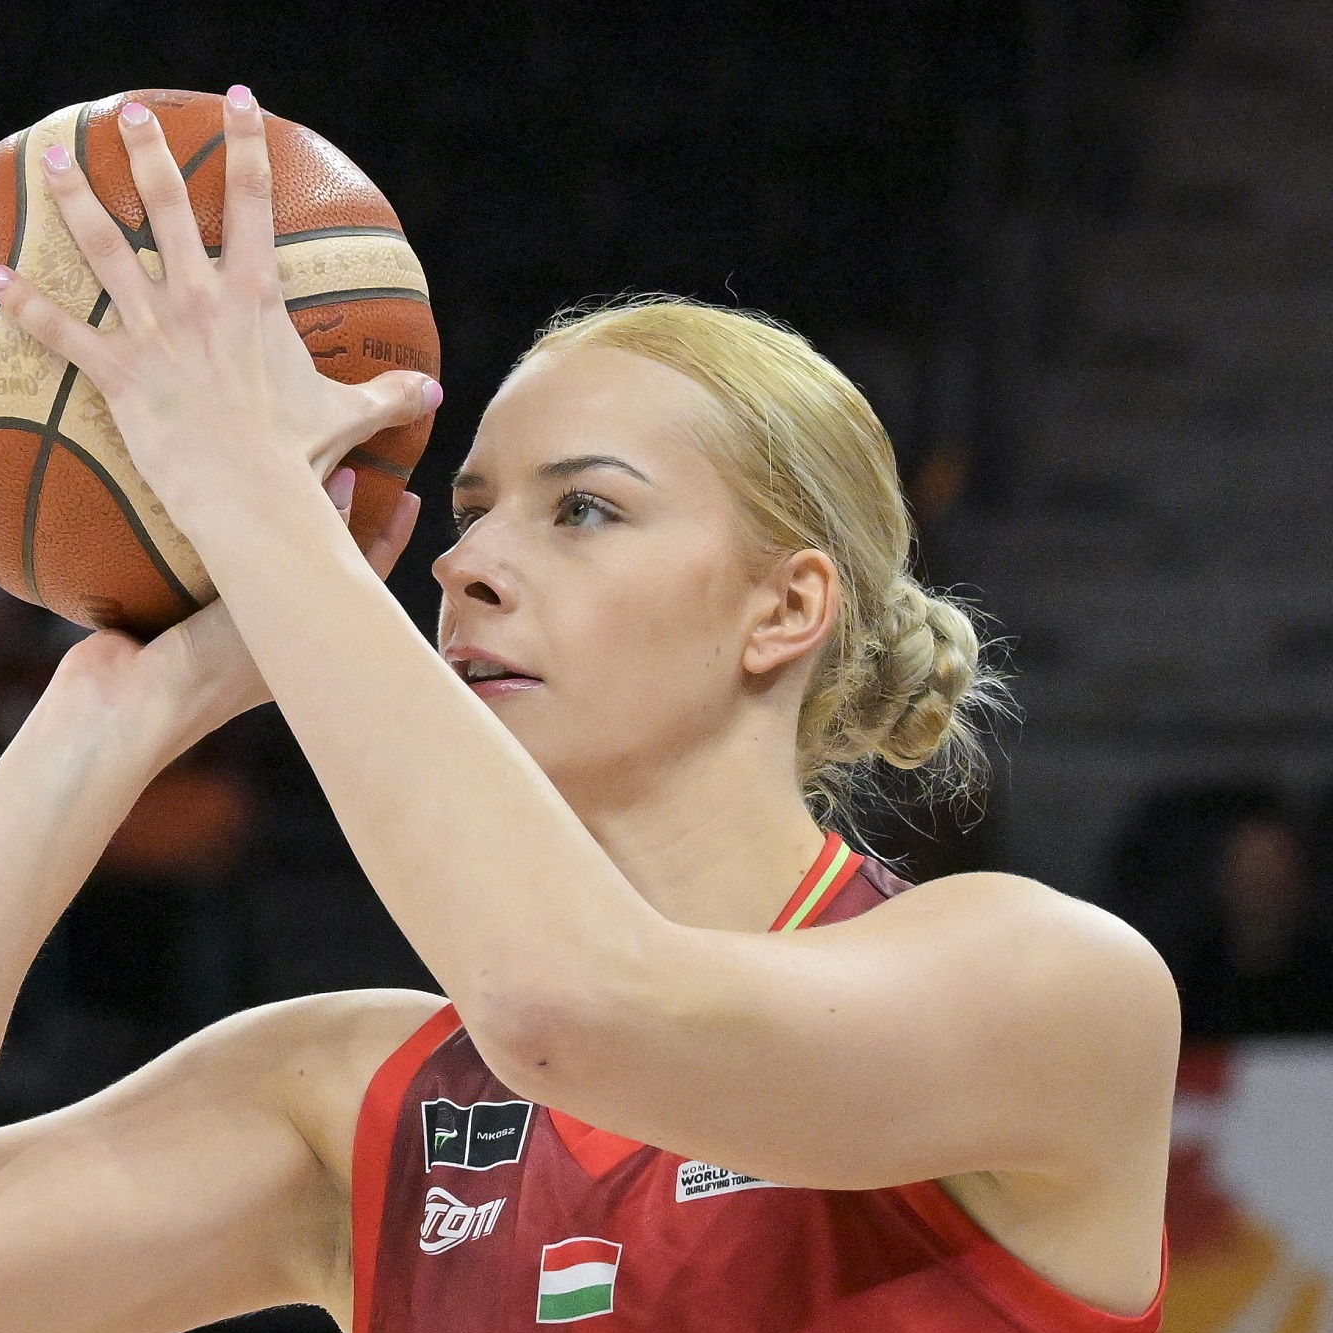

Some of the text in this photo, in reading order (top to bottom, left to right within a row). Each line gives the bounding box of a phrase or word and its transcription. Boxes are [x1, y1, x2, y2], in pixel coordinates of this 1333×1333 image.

[362, 336, 392, 363] FIBA
[681, 1168, 729, 1187] WORLD
[685, 1178, 730, 1196] QUALIFYING
